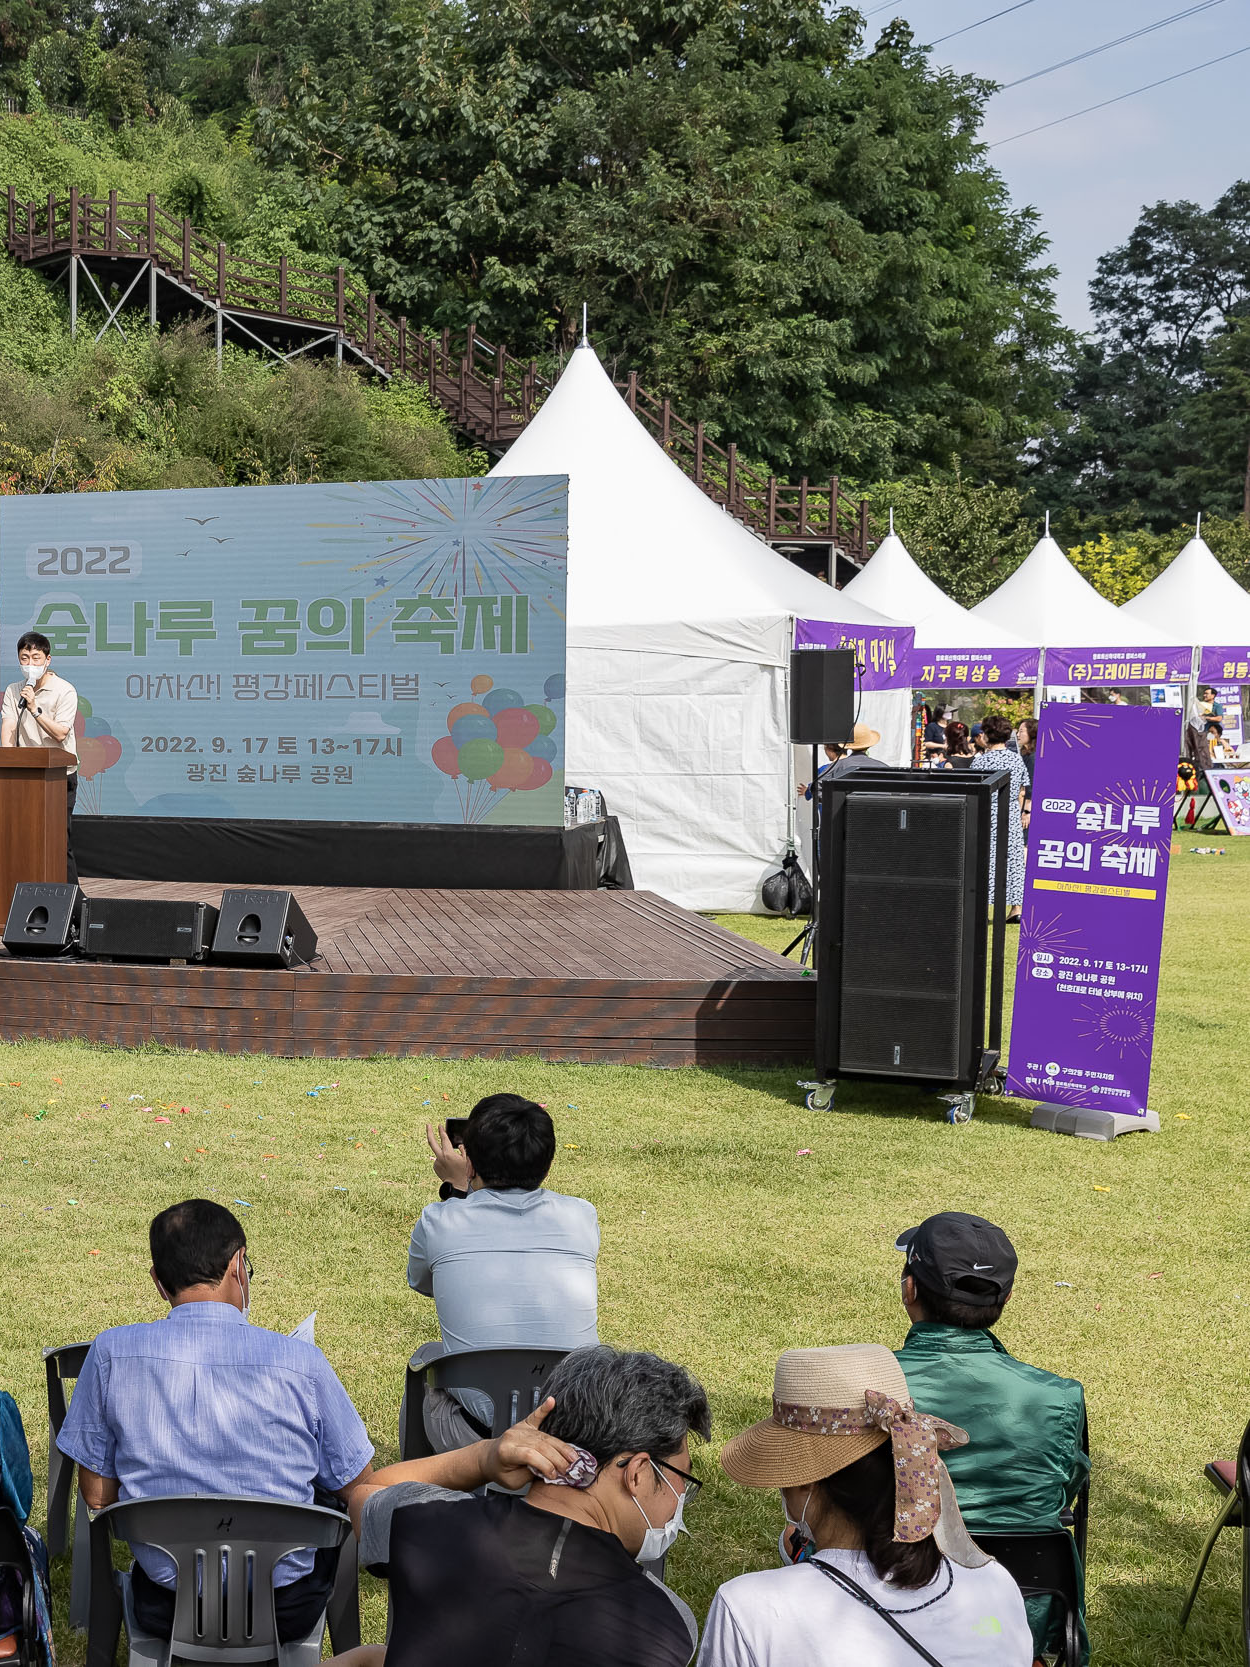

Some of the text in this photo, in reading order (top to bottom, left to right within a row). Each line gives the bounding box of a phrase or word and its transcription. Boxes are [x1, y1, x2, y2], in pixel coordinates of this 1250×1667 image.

[37, 546, 131, 576] 2022
[32, 593, 528, 657] 숲나루 꿈의 축제
[870, 638, 897, 676] 대기실
[1068, 662, 1168, 681] (주)그레이트퍼즐
[1223, 661, 1250, 678] 협동
[125, 673, 420, 701] 아차산! 평강페스티벌
[140, 736, 403, 757] 2022. 9. 17 토 13~17시
[186, 763, 353, 785] 광진 숲나루 공원
[1045, 801, 1072, 811] 2022
[1076, 802, 1160, 835] 숲나루
[1037, 839, 1157, 877] 꿈의 축제
[1059, 956, 1081, 966] 2022.
[1083, 959, 1091, 967] 9.
[1094, 960, 1103, 969] 17
[1105, 961, 1113, 970] 토
[1058, 970, 1116, 985] 광진 숲나루 공원
[531, 1363, 546, 1376] H
